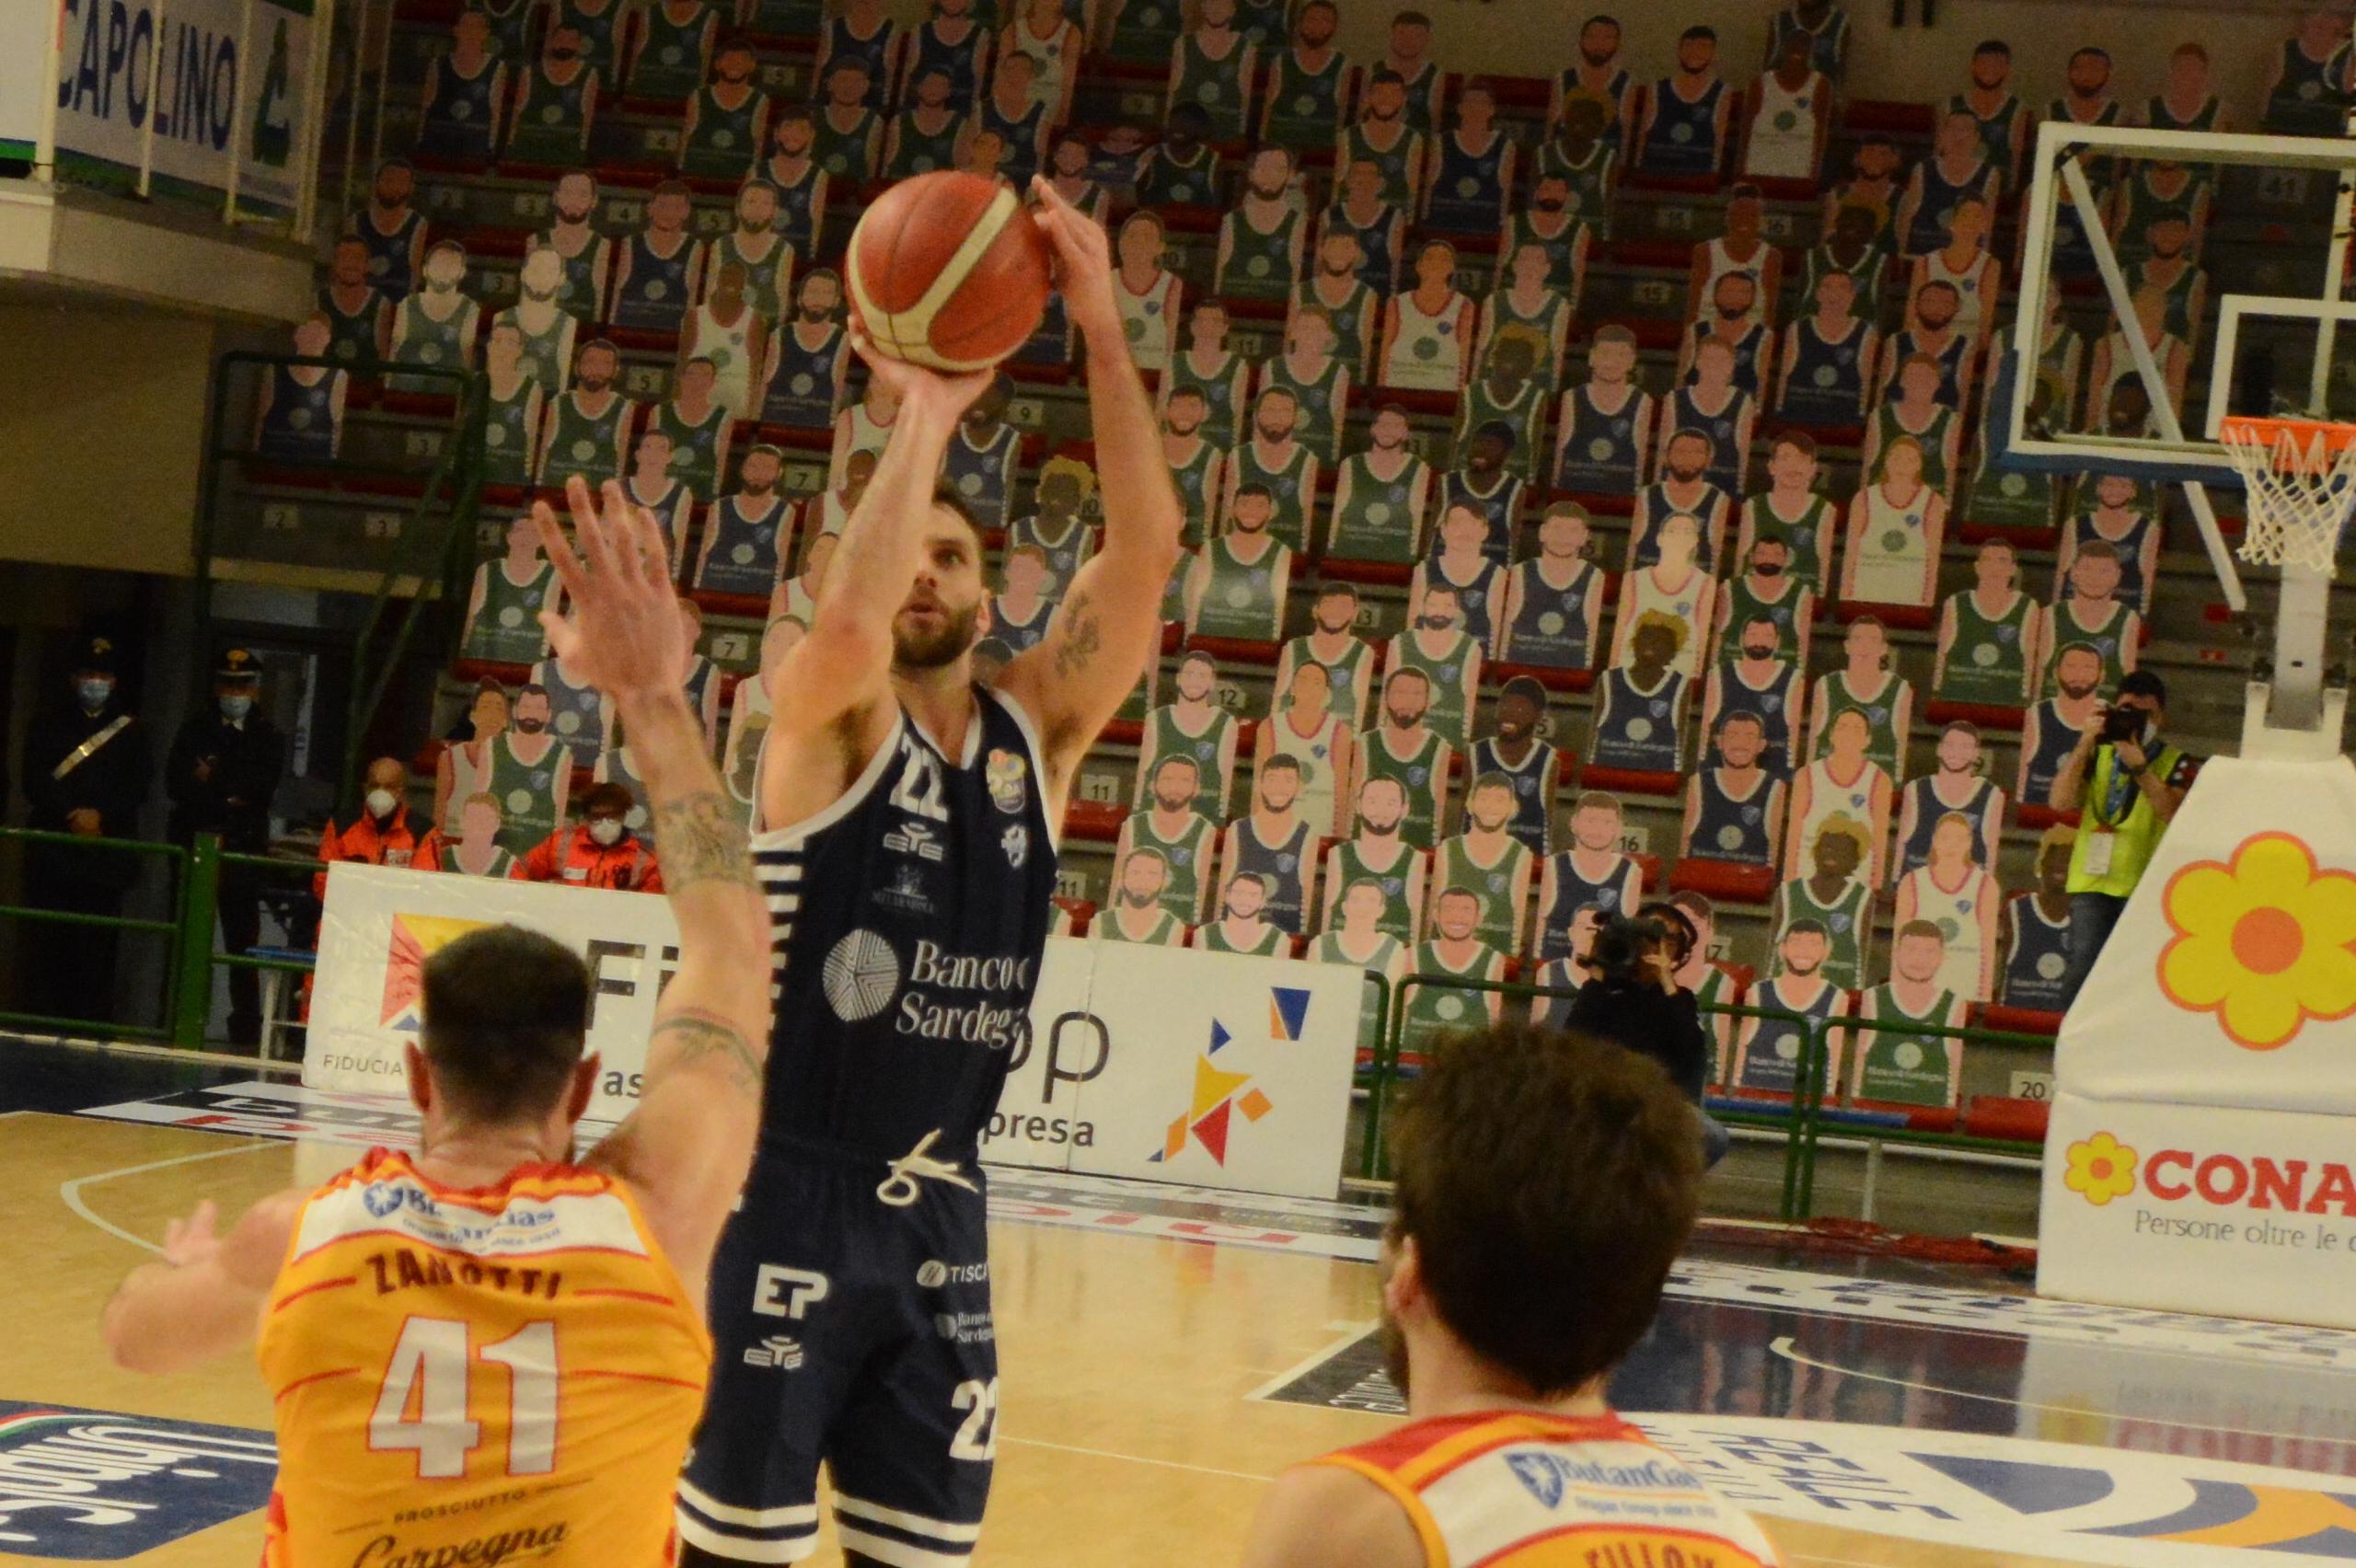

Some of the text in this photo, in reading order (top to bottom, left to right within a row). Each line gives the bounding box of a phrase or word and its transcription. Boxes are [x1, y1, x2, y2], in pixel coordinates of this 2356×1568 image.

[619, 206, 629, 222] 4
[639, 374, 651, 392] 5
[1020, 406, 1031, 421] 9
[797, 473, 807, 490] 7
[724, 640, 735, 658] 7
[1218, 689, 1238, 708] 12
[1091, 785, 1110, 801] 11
[1620, 836, 1640, 853] 16
[1058, 880, 1078, 897] 11
[910, 940, 1014, 991] Banco
[2021, 1080, 2046, 1100] 20
[2134, 1209, 2235, 1240] Persone
[2245, 1220, 2305, 1246] oltre
[2316, 1224, 2338, 1250] le
[365, 1248, 564, 1300] ZANOTTI
[752, 1262, 829, 1320] EP
[368, 1314, 560, 1480] 41
[393, 1489, 527, 1525] PROSCIUTTO
[352, 1520, 568, 1568] Carpegna
